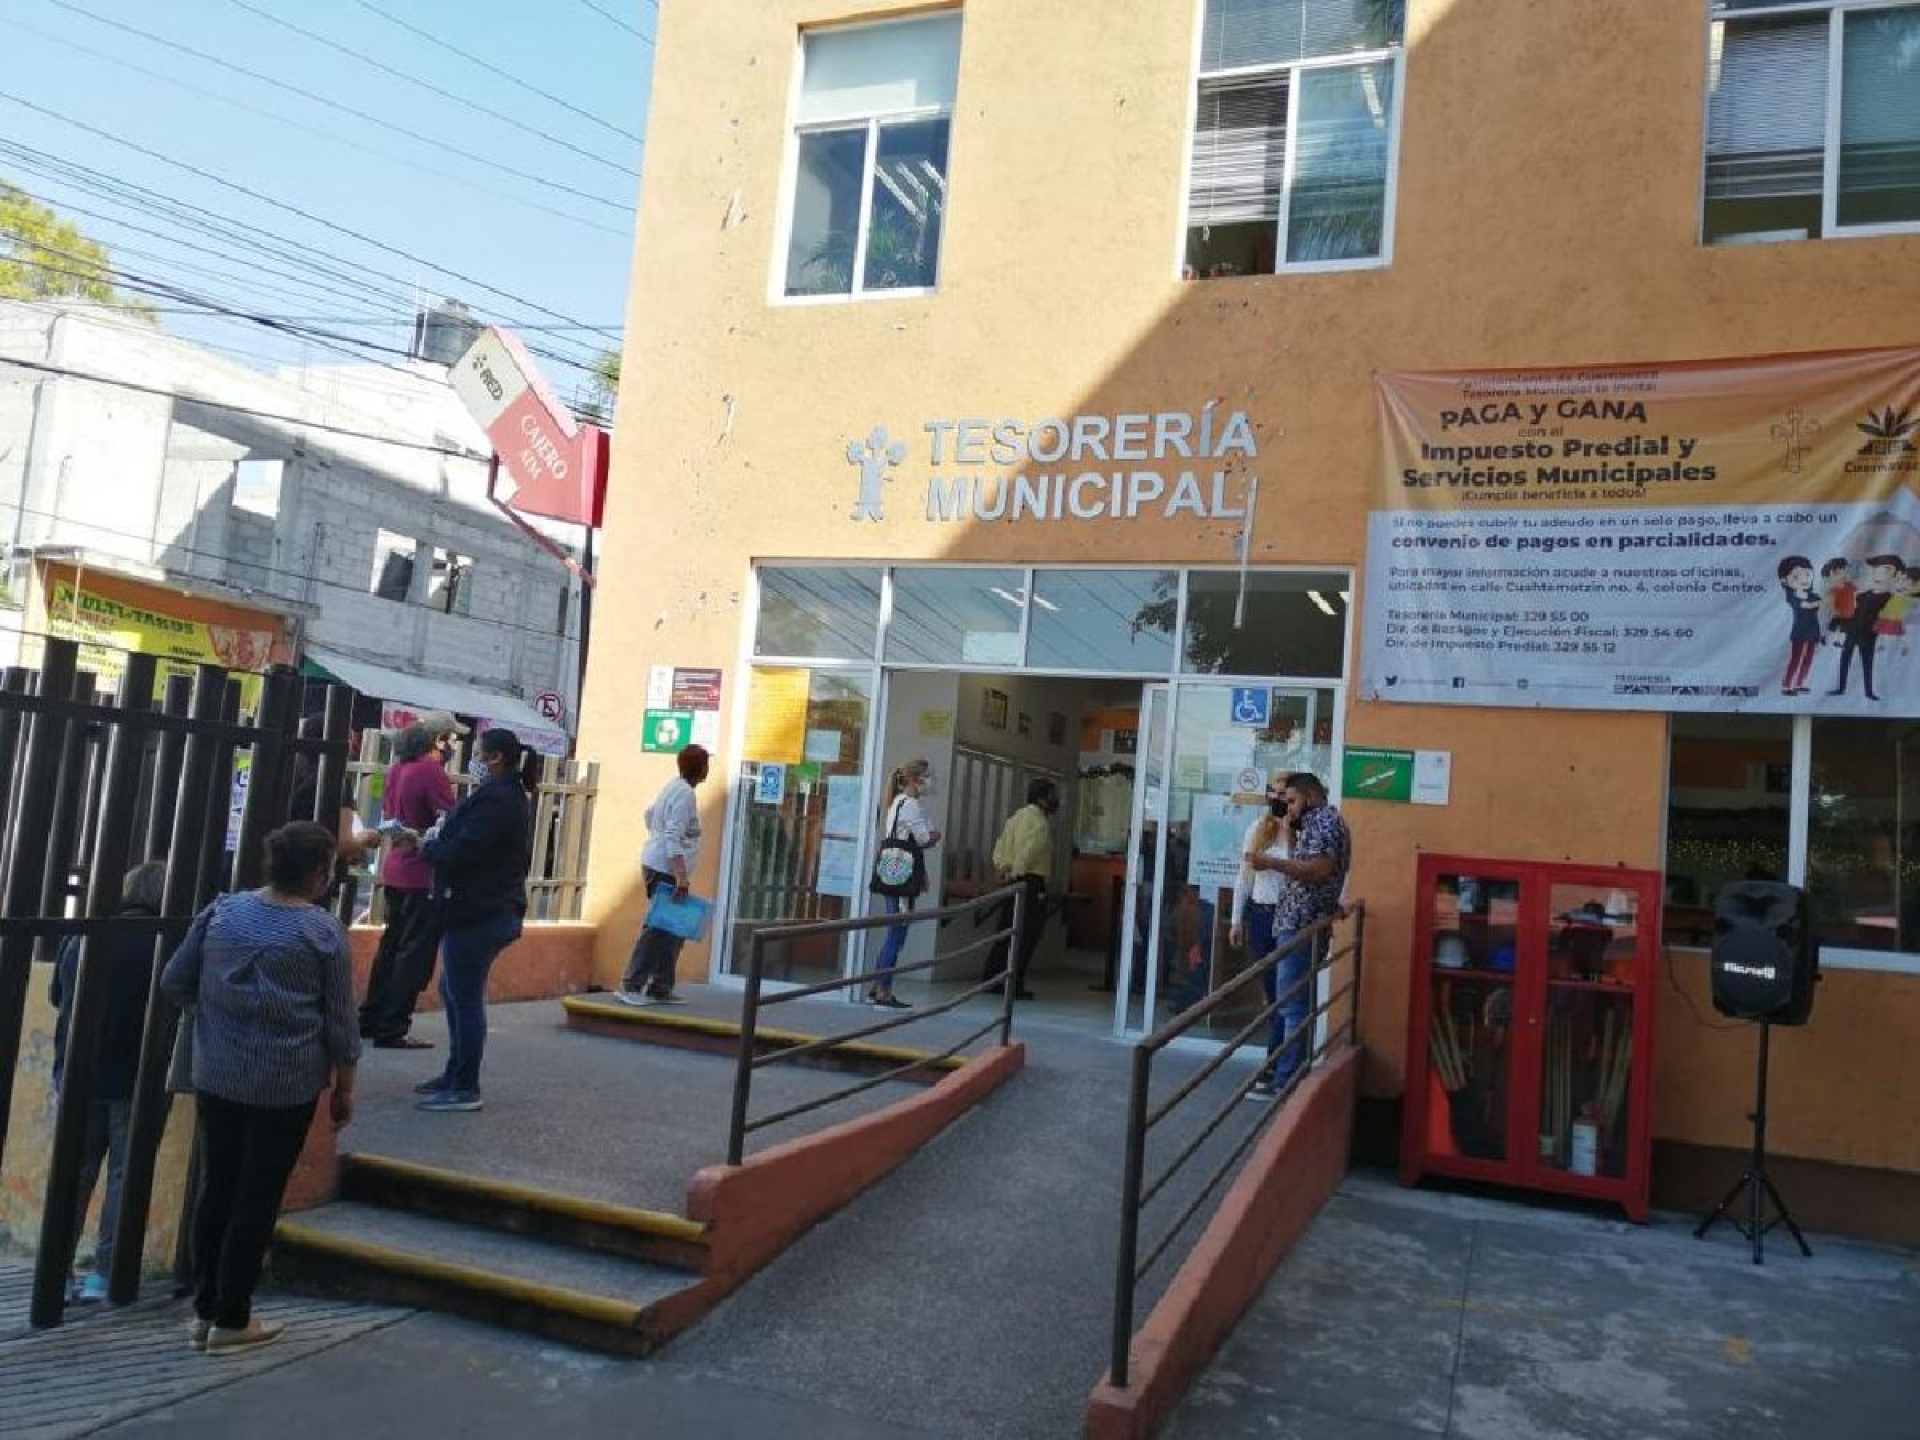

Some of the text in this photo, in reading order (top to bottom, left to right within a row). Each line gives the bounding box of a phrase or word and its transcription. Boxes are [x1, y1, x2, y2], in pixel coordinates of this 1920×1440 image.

[1440, 399, 1648, 431] PAGA y GANA
[923, 397, 1259, 466] TESORERÍA
[1518, 424, 1563, 438] con el
[520, 414, 569, 480] CAJERO
[1421, 434, 1697, 466] Impuesto Predial y
[1403, 460, 1716, 487] Servicios Municipales
[925, 471, 1247, 522] MUNICIPAL
[1602, 487, 1647, 499] todos!
[1407, 516, 1423, 527] no
[1427, 516, 1474, 529] puedes
[1478, 515, 1518, 528] cubrir
[1524, 516, 1537, 527] tu
[1541, 515, 1594, 527] adeudo
[1600, 517, 1616, 526] en
[1622, 517, 1639, 526] un
[1645, 514, 1673, 526] solo
[1678, 514, 1720, 527] pago,
[1723, 512, 1758, 524] lleva
[1763, 514, 1772, 524] a
[1776, 511, 1813, 524] cabo
[1819, 512, 1838, 524] un
[1392, 531, 1777, 553] convenio de pagos en parcialidades.
[1389, 566, 1418, 578] Para
[1422, 567, 1462, 579] mayor
[1466, 565, 1549, 578] información
[1553, 566, 1596, 578] acude
[1613, 567, 1678, 578] nuestras
[1451, 584, 1466, 593] en
[1472, 581, 1501, 593] calle
[1654, 581, 1707, 593] colonia
[1570, 611, 1589, 622] 00
[1413, 624, 1428, 634] de
[1623, 628, 1649, 638] 329
[1431, 639, 1494, 651] Impuesto
[1554, 642, 1579, 653] 329
[1583, 642, 1598, 653] 55
[1603, 643, 1616, 653] 12
